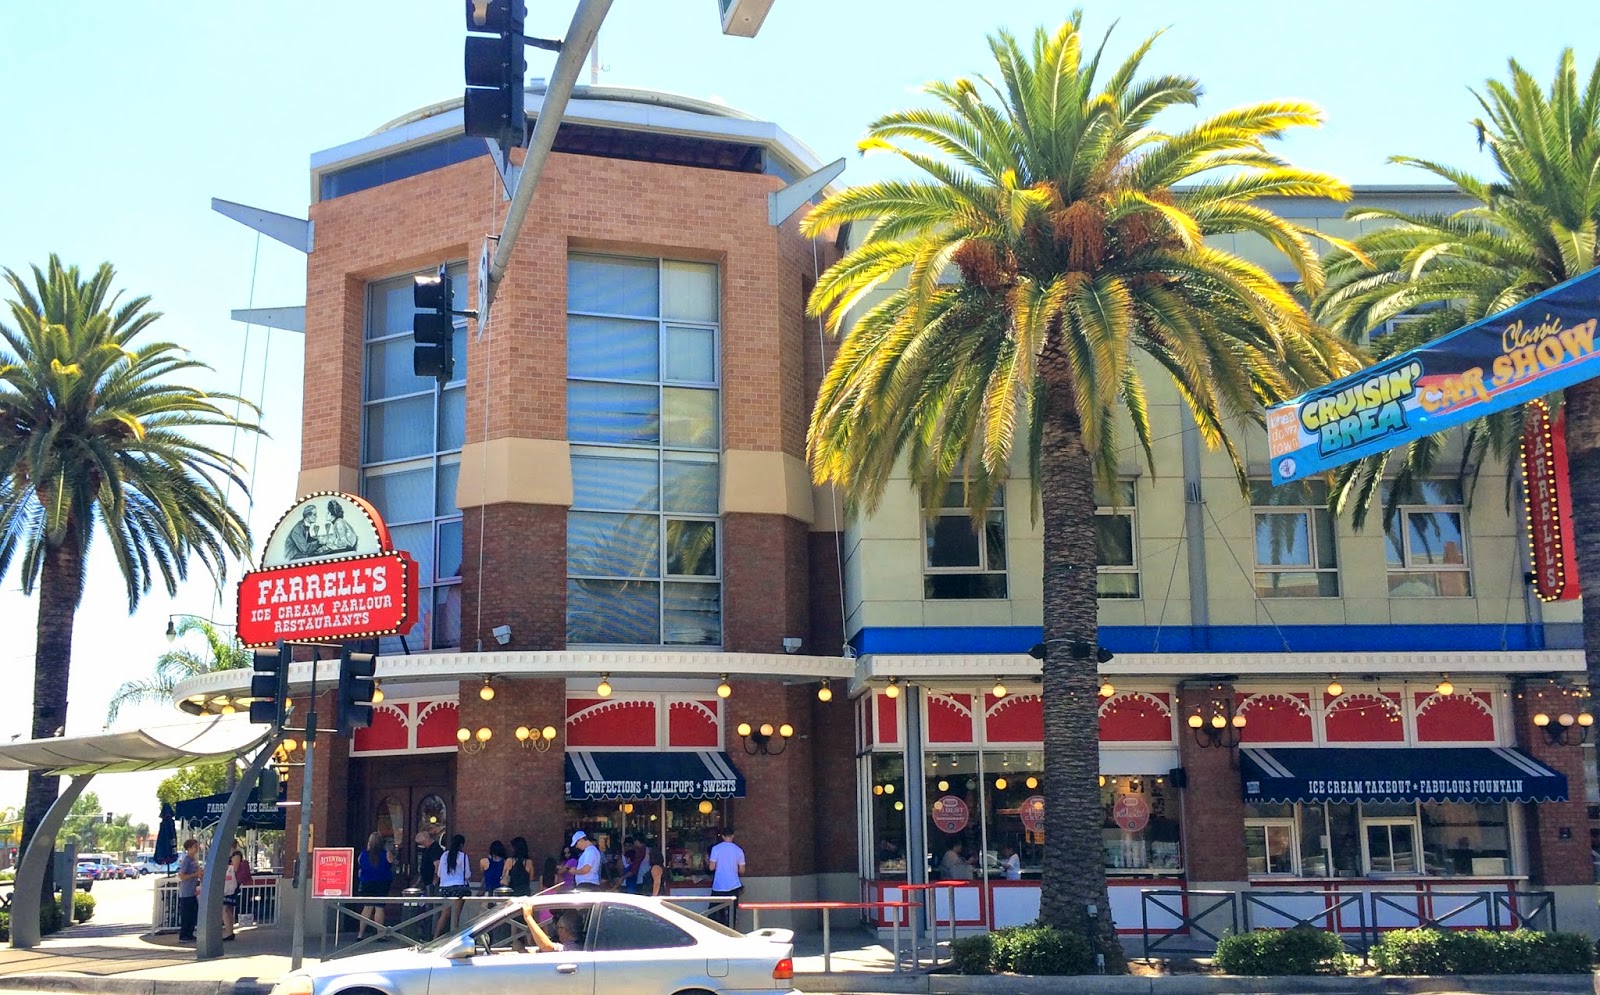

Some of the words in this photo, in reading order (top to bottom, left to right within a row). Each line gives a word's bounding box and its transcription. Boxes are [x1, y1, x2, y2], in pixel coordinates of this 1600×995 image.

[1502, 313, 1563, 353] Classic
[1418, 366, 1492, 412] CAR
[1492, 318, 1598, 387] SHOW
[1301, 362, 1421, 430] CRUISIN'
[1321, 400, 1404, 453] BREA
[1273, 438, 1299, 455] town
[258, 566, 387, 605] FARRELL'S
[251, 608, 271, 622] ICE
[278, 603, 324, 620] CREAM
[332, 595, 392, 614] PARLOUR
[274, 612, 369, 633] RESTAURANTS
[584, 780, 641, 794] CONFECTIONS
[651, 780, 694, 793] LOLLIPOPS
[703, 780, 736, 793] SWEETS
[1309, 780, 1325, 794] ICE
[1328, 780, 1363, 794] CREAM
[1365, 780, 1411, 794] TAKEOUT
[1420, 780, 1471, 793] FABULOUS
[1473, 780, 1523, 793] FOUNTAIN
[247, 803, 258, 812] ICE
